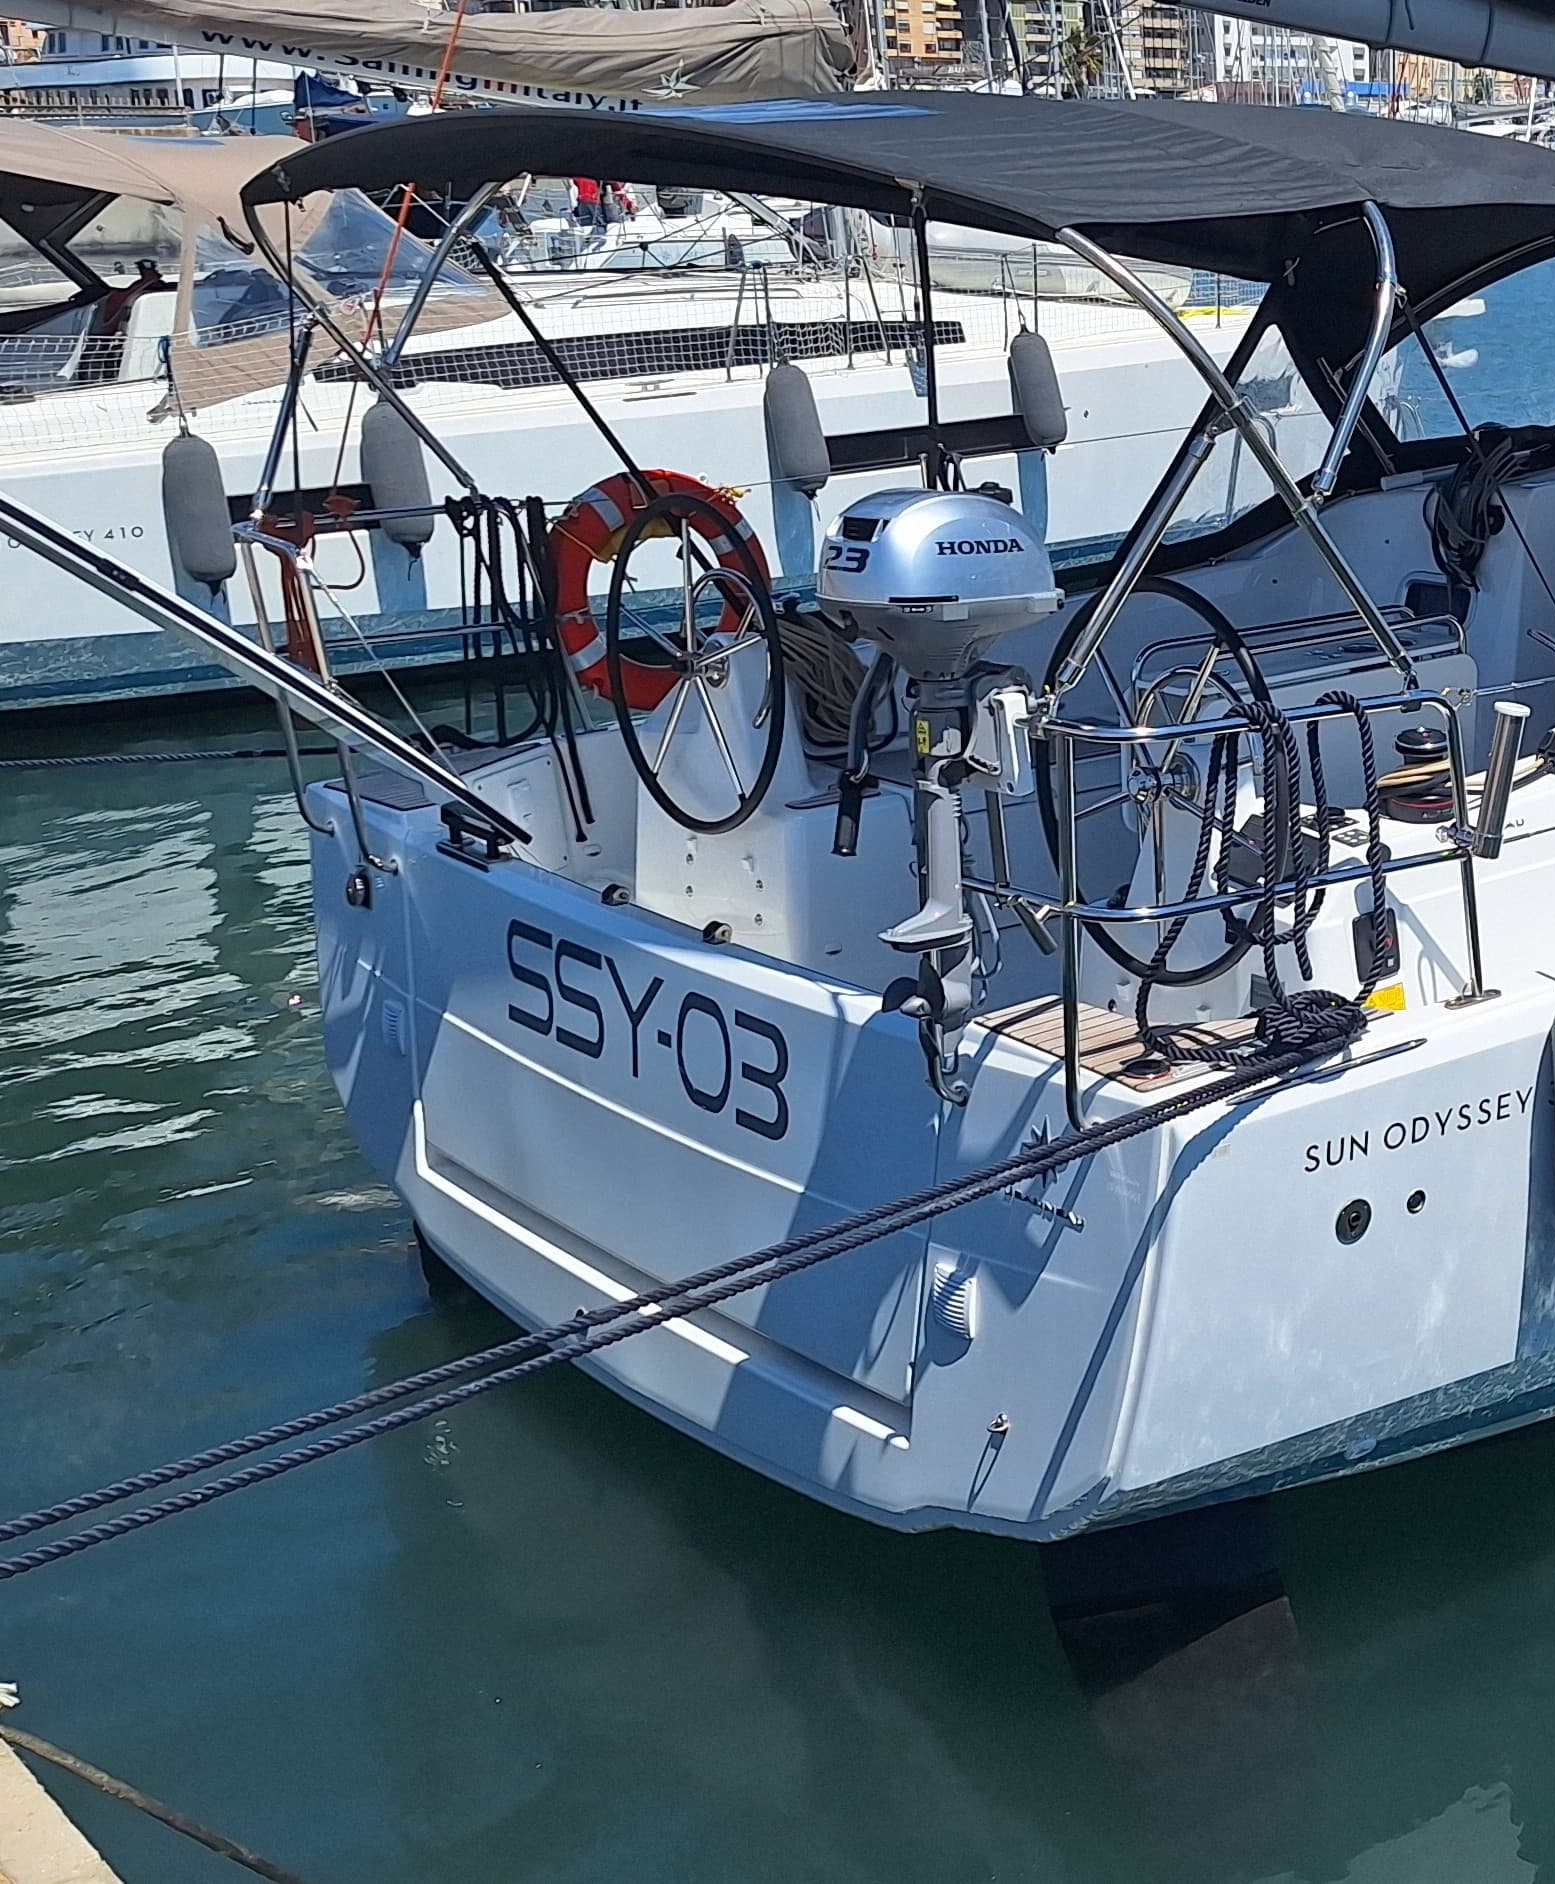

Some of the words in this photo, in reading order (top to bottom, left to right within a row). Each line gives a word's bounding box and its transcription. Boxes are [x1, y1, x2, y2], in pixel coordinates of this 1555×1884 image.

[103, 526, 144, 539] 410
[936, 538, 1025, 556] HONDA
[507, 918, 789, 1141] SSY-03
[1304, 1130, 1370, 1173] SUN
[1383, 1086, 1534, 1150] ODYSSEY
